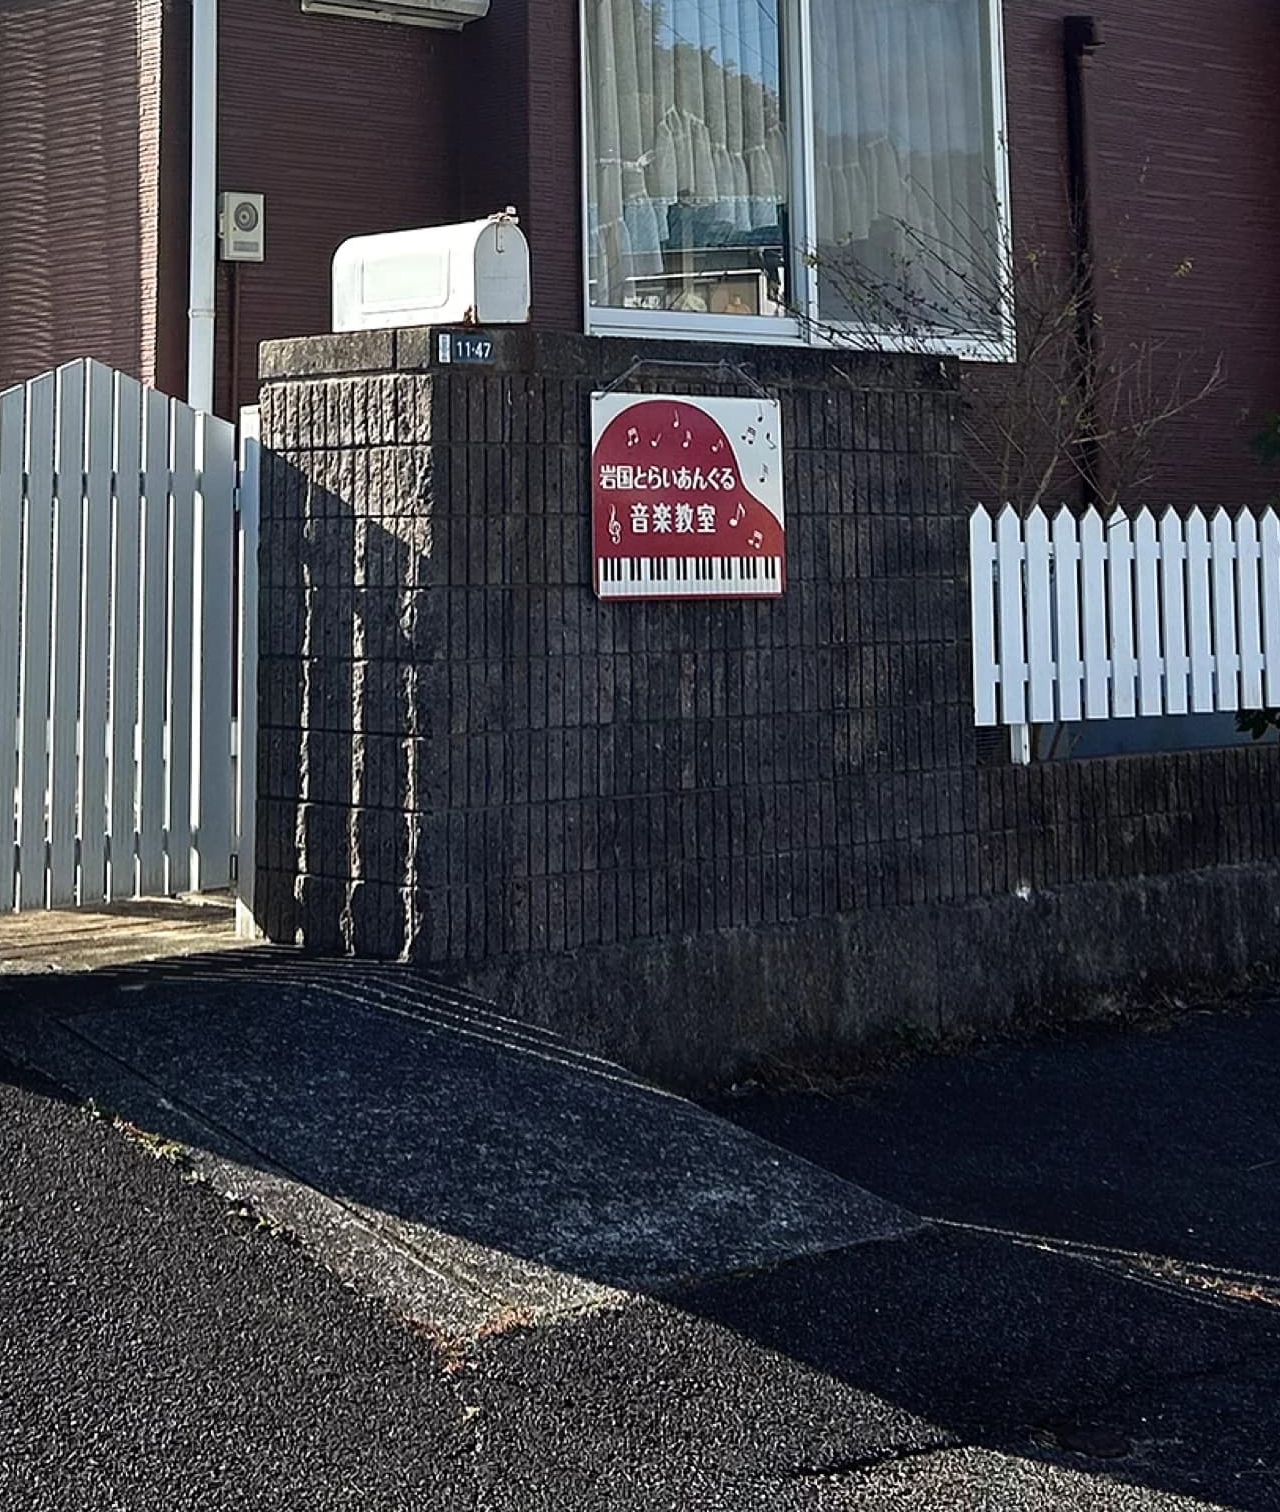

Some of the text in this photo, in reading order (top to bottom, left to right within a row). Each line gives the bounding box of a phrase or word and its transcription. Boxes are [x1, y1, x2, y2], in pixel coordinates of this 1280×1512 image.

[600, 464, 735, 491] 岩国とらいあんぐる
[630, 502, 716, 534] 音楽教室
